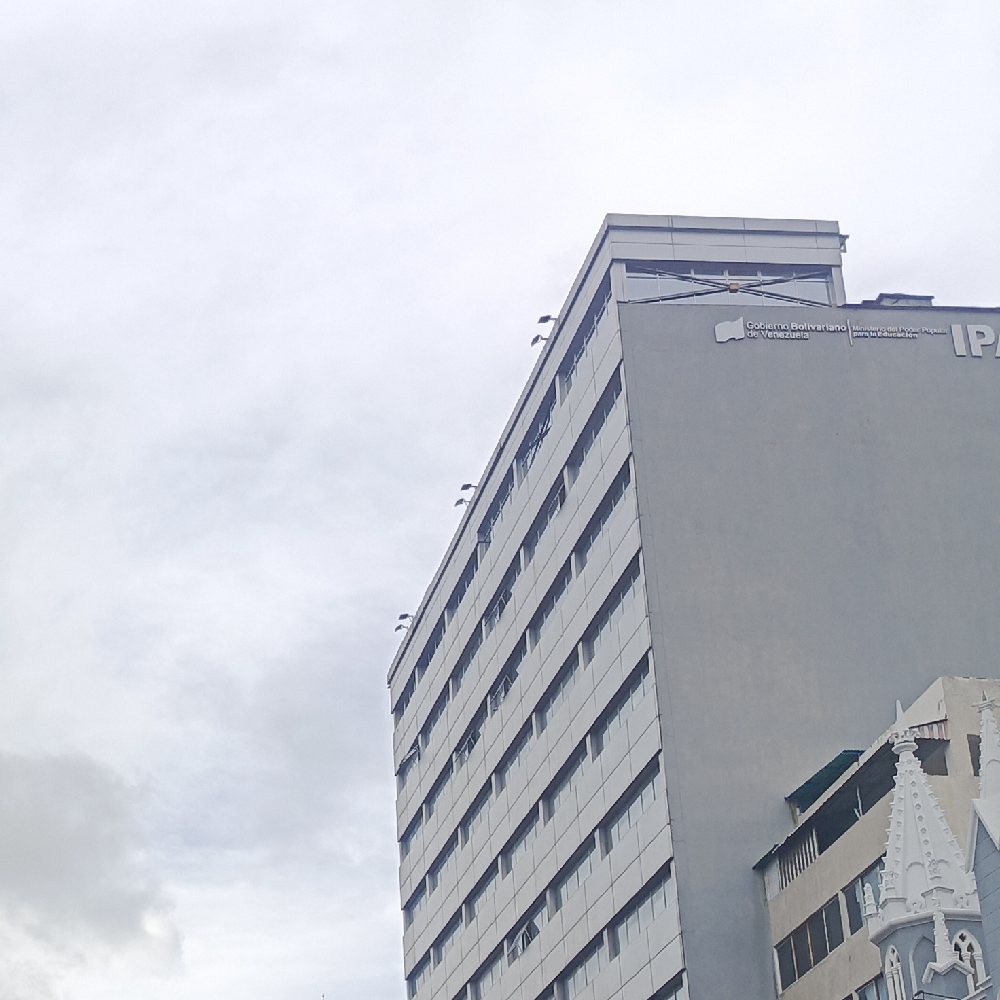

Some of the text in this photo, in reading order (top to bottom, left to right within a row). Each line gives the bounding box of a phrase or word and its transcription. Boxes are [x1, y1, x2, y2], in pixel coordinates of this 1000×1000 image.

[746, 321, 847, 332] Gobierno Bolivariano
[747, 330, 809, 340] de Venezuela
[950, 324, 1000, 357] IP
